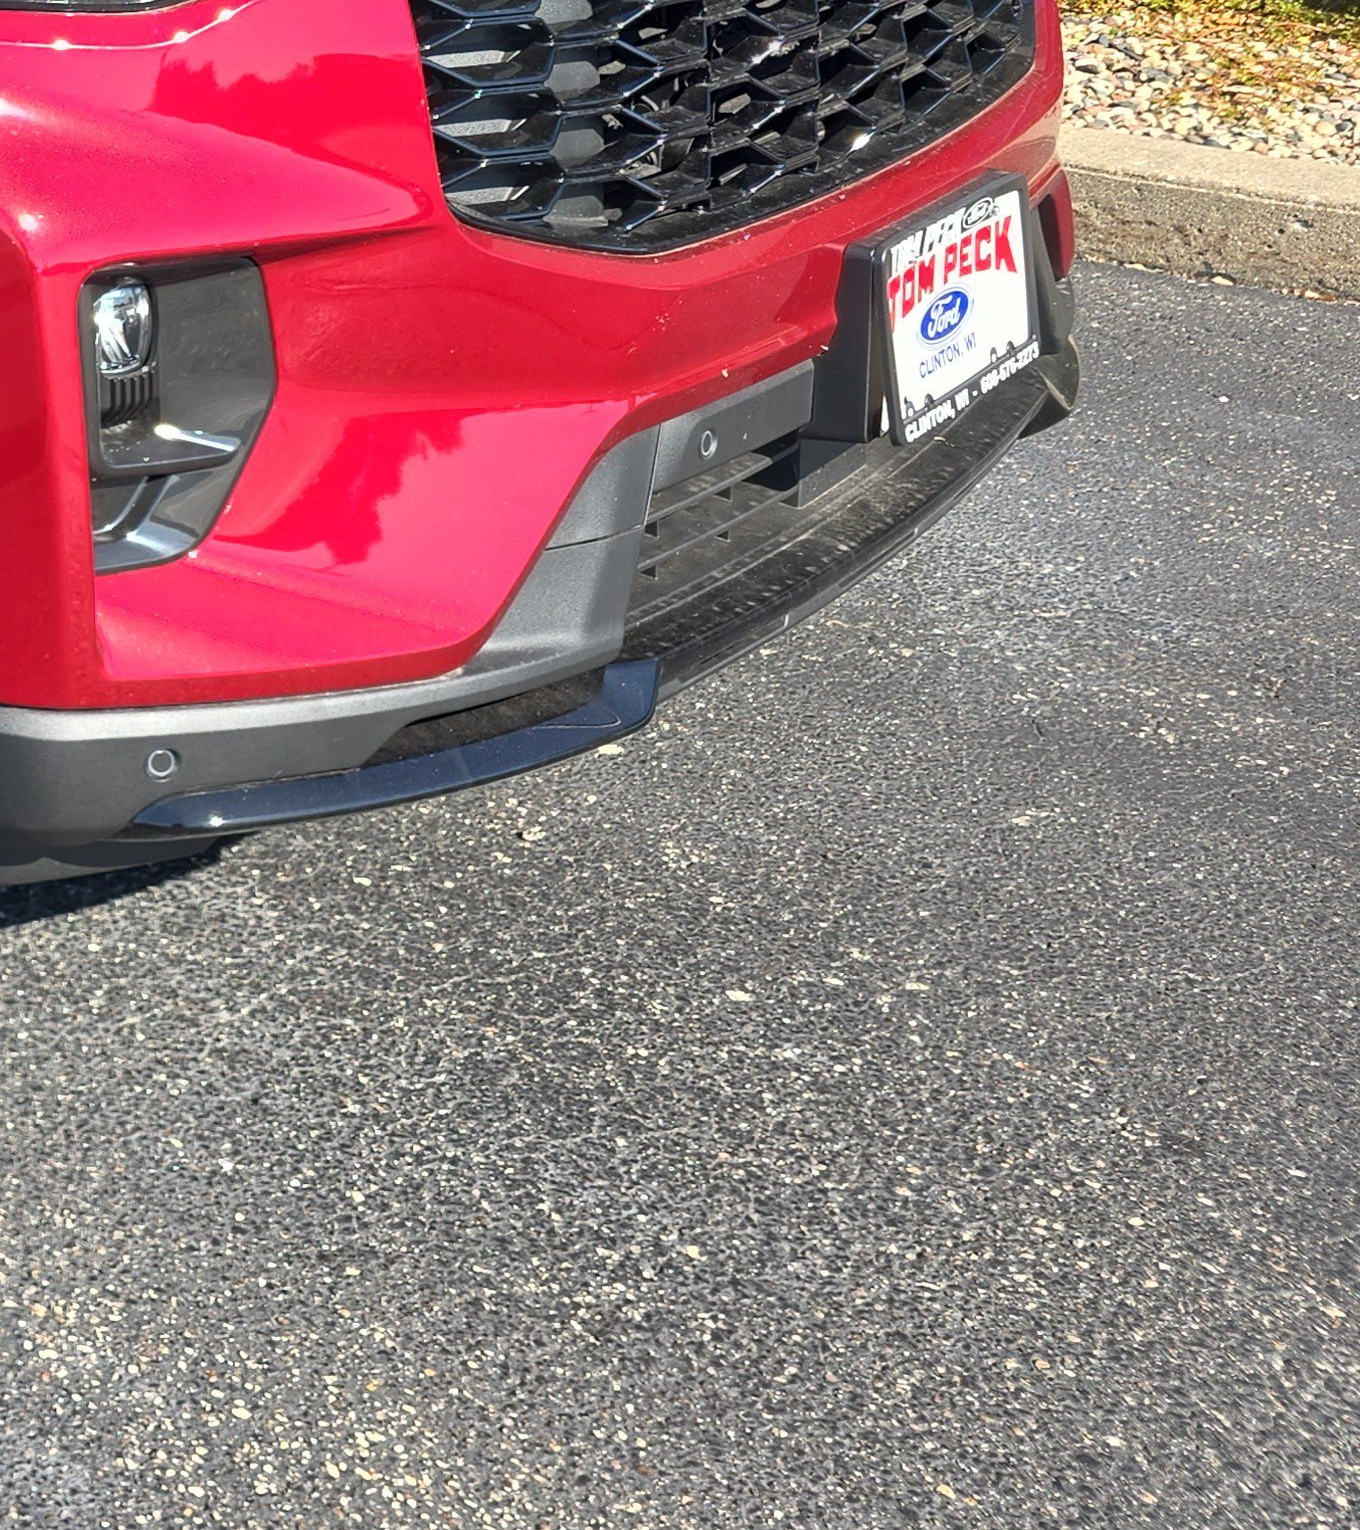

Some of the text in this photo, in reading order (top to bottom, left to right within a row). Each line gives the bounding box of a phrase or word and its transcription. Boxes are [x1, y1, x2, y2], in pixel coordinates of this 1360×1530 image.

[886, 215, 1018, 334] TOM PECK
[927, 294, 962, 339] Ford
[904, 399, 957, 443] CLINTON,
